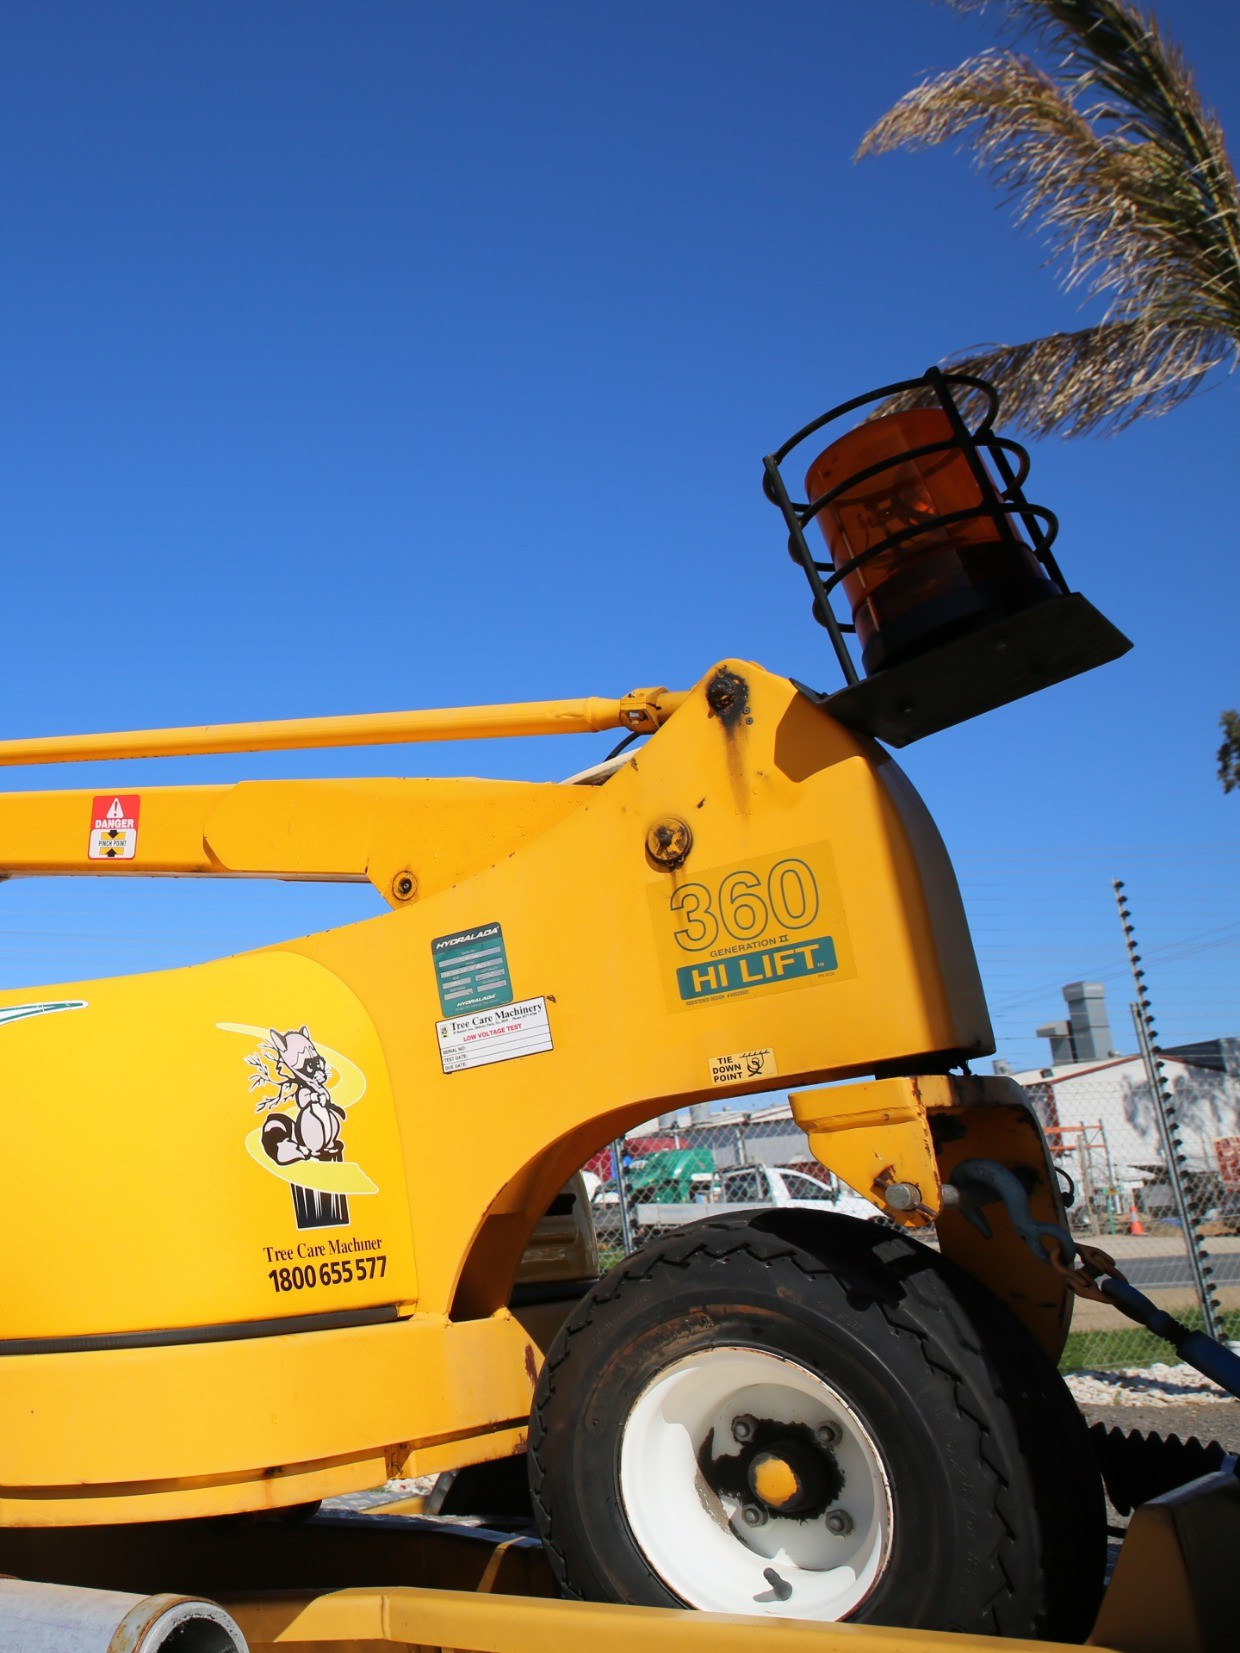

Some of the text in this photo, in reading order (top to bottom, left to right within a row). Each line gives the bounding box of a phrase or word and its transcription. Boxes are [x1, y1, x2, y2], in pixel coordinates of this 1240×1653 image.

[95, 818, 134, 829] DANGER
[670, 858, 820, 952] 360
[435, 927, 498, 949] HYDRALADA
[710, 937, 777, 957] GENERATION
[691, 963, 729, 992] HI
[739, 944, 820, 983] LIFT
[456, 993, 496, 1007] HYDRALADA
[451, 1021, 470, 1031] Tree
[472, 1015, 493, 1025] Care
[495, 1003, 542, 1020] Machinery
[463, 1033, 477, 1042] LOW
[478, 1026, 505, 1038] VOLTAGE
[507, 1023, 522, 1031] TEST
[712, 1063, 742, 1075] DOWN
[717, 1056, 733, 1065] TIE
[713, 1071, 743, 1083] POINT
[263, 1246, 294, 1263] Tree
[297, 1242, 325, 1259] Care
[268, 1255, 387, 1293] 1800 655 577
